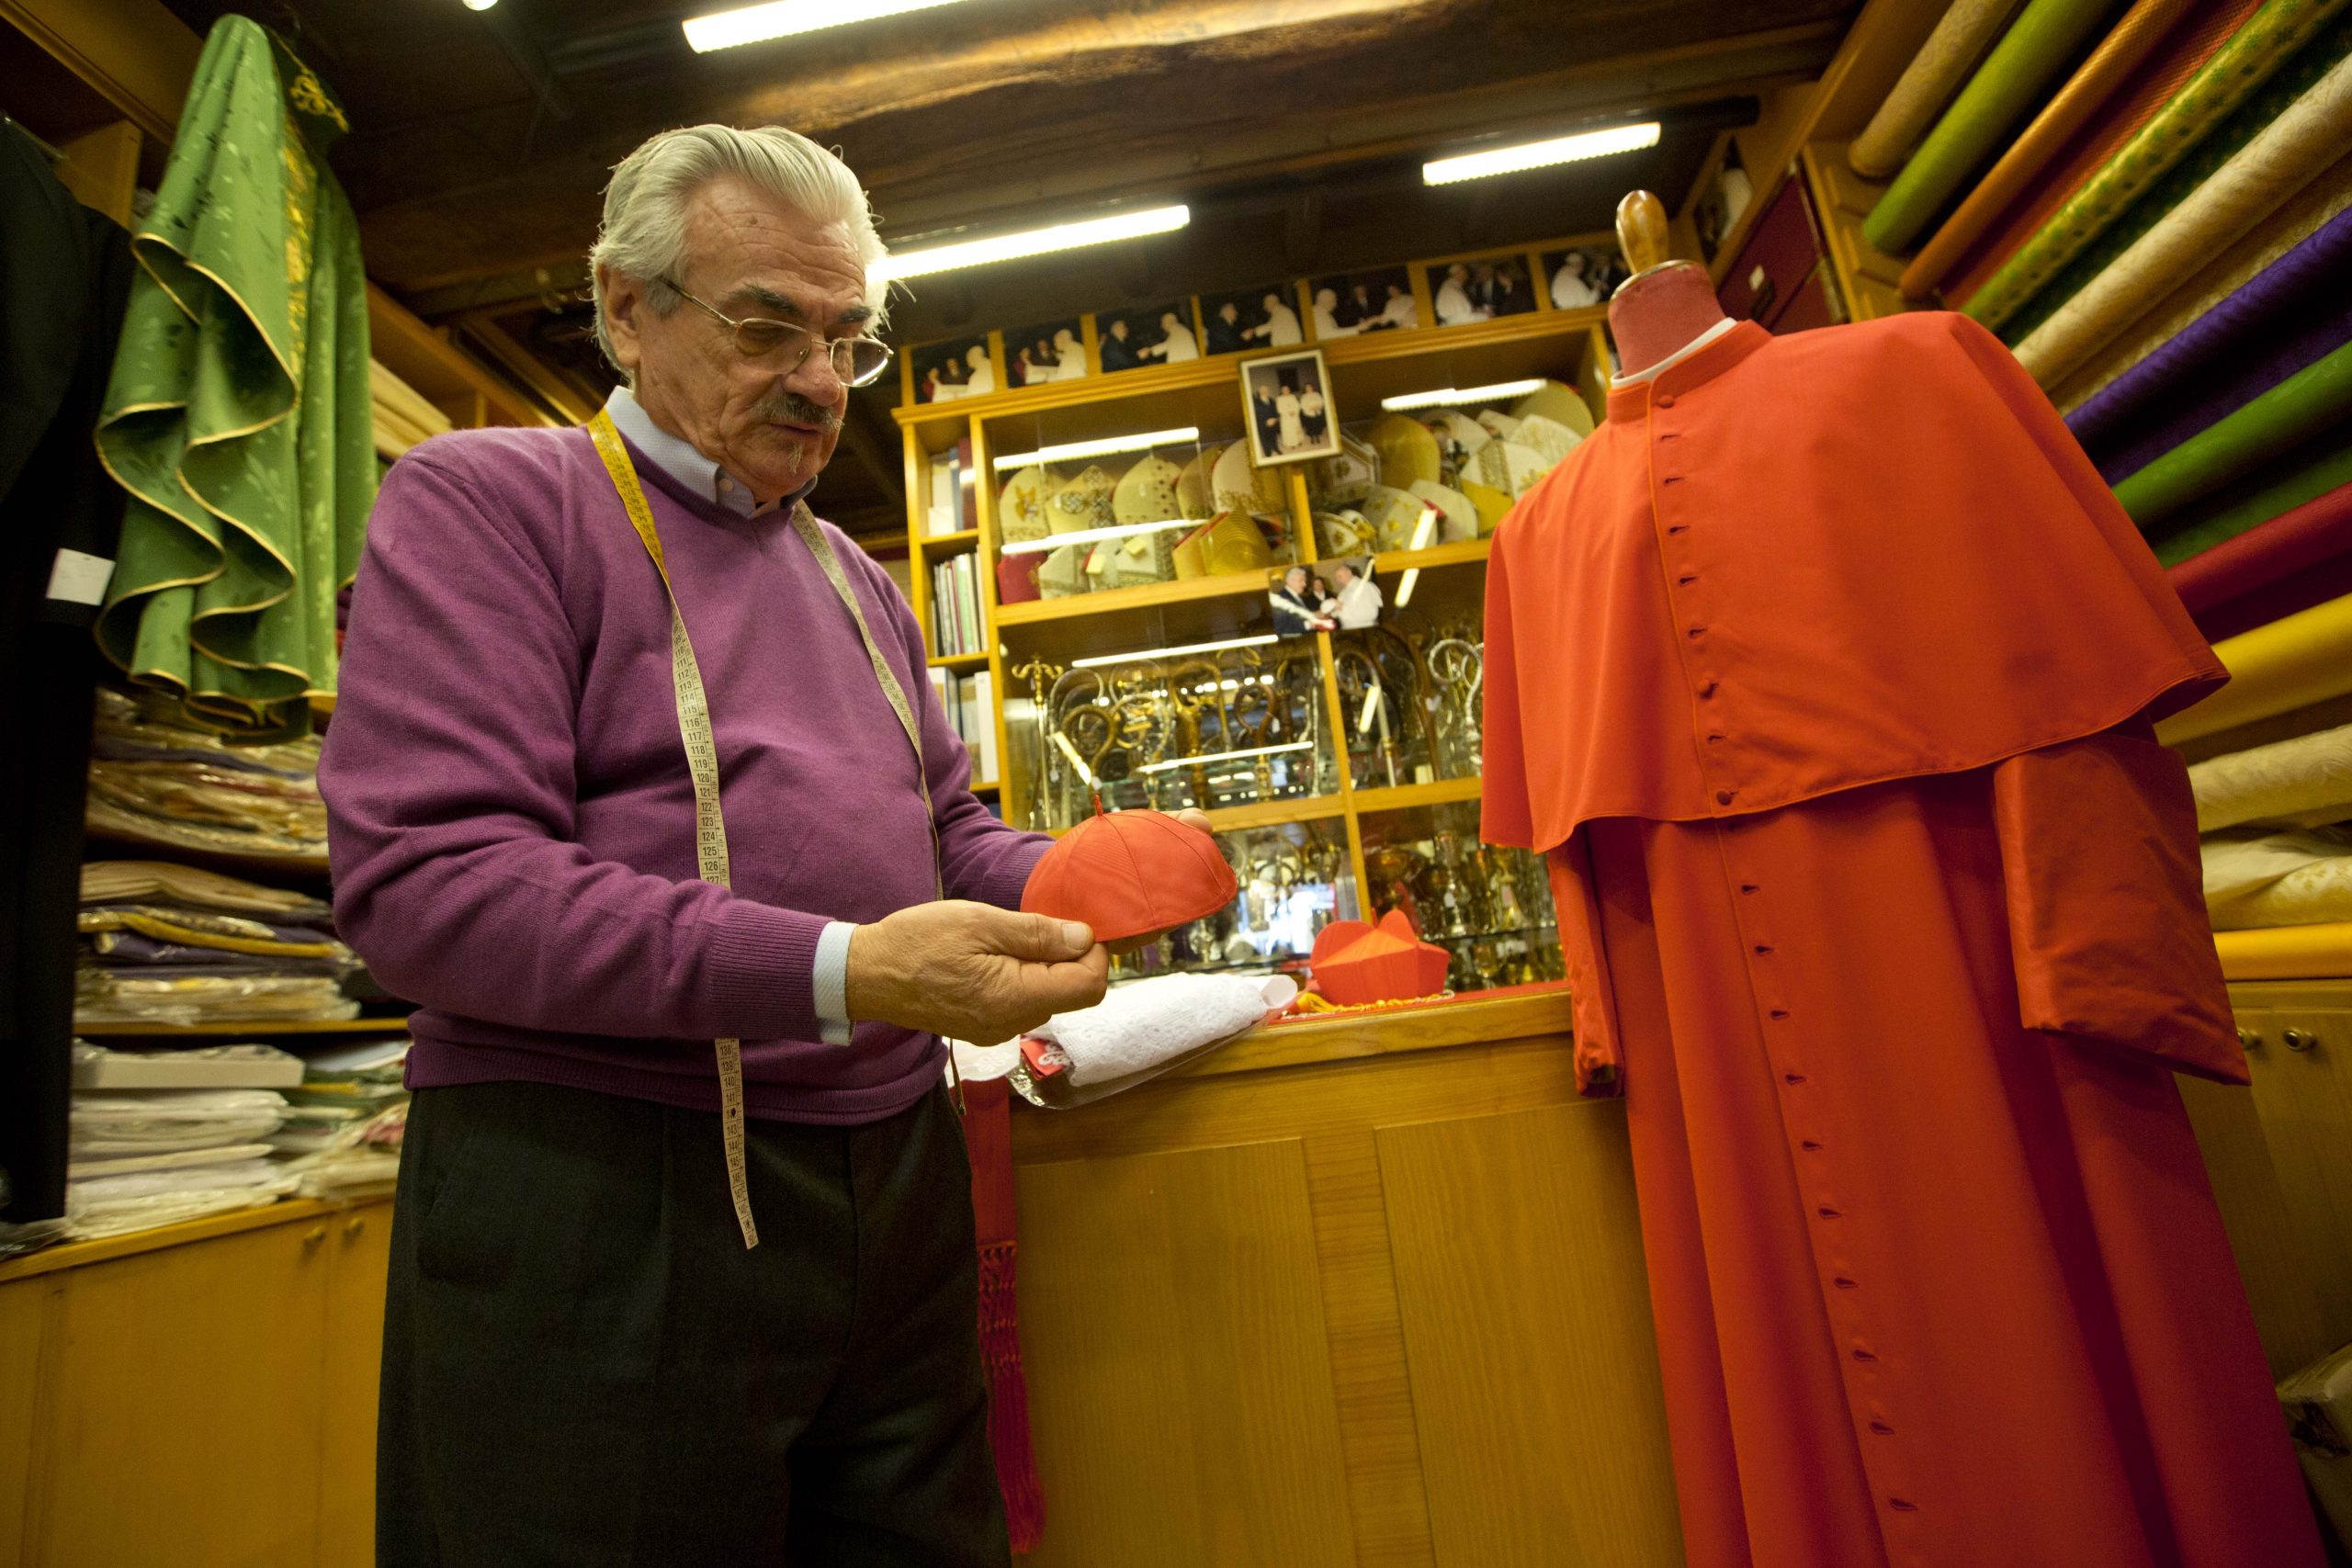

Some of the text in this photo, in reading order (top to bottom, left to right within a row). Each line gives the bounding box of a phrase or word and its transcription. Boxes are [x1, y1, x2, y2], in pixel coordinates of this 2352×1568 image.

[676, 658, 687, 669] 111
[677, 669, 690, 680] 112
[679, 681, 693, 692] 113
[681, 692, 695, 704] 114
[683, 705, 697, 716] 115
[684, 717, 700, 728] 116
[688, 731, 703, 741] 117
[691, 745, 706, 755] 118
[694, 759, 708, 769] 119
[696, 773, 710, 783] 120
[699, 787, 711, 797] 121
[701, 802, 712, 812] 122
[702, 817, 714, 827] 123
[702, 831, 716, 841] 124
[703, 846, 718, 856] 125
[704, 861, 718, 871] 126
[719, 1044, 732, 1056] 138
[721, 1060, 733, 1072] 139
[724, 1077, 734, 1088] 140
[726, 1092, 735, 1103] 141
[727, 1123, 738, 1136] 143
